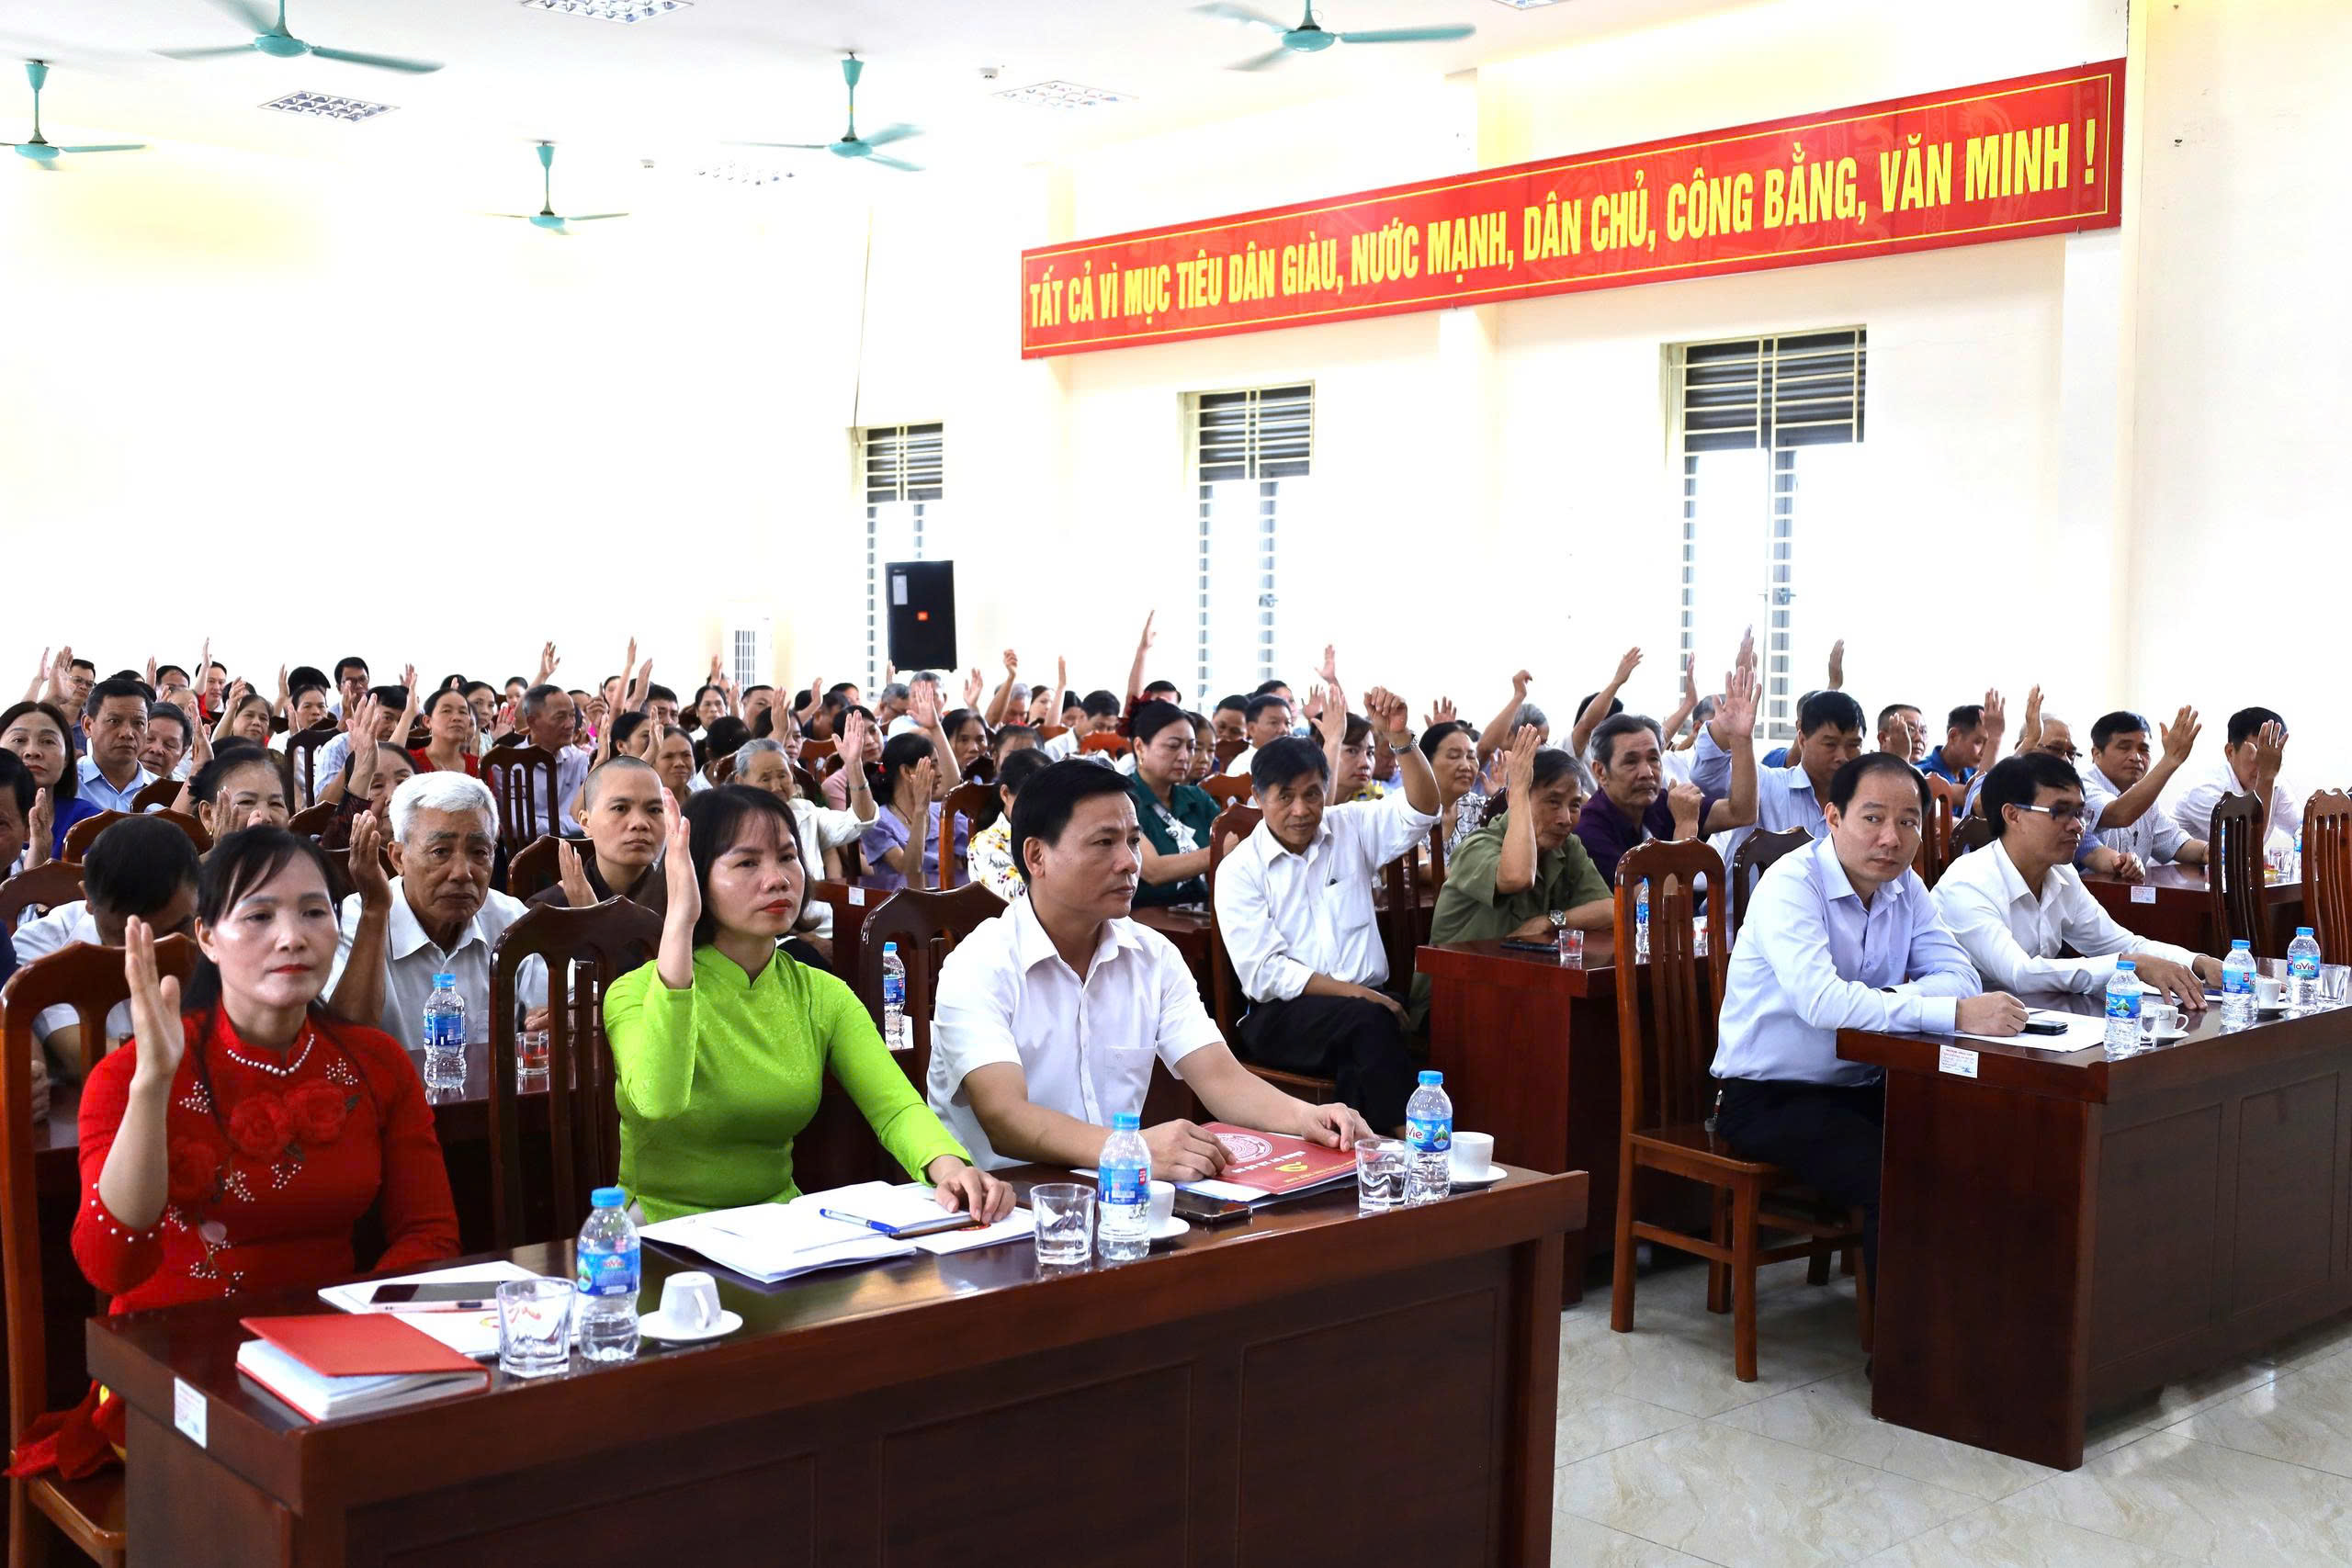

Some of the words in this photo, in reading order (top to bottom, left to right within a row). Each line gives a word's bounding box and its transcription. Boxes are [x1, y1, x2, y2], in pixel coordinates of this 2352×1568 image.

[1029, 264, 1064, 329] TẤT
[1068, 259, 1094, 324] CẢ
[1099, 262, 1118, 320] VÌ
[1124, 264, 1170, 324] MỤC
[1176, 248, 1223, 310] TIÊU
[1228, 240, 1275, 304] DÂN
[1282, 231, 1343, 297] GIÀU,
[1351, 216, 1419, 288] NƯỚC
[1428, 210, 1514, 284] MẠNH,
[1523, 190, 1581, 262] DÂN
[1591, 169, 1656, 253] CHỦ,
[1667, 166, 1753, 243] CÔNG
[1764, 141, 1867, 229] BẰNG,
[1880, 132, 1952, 214] VĂN
[1965, 122, 2069, 202] MINH
